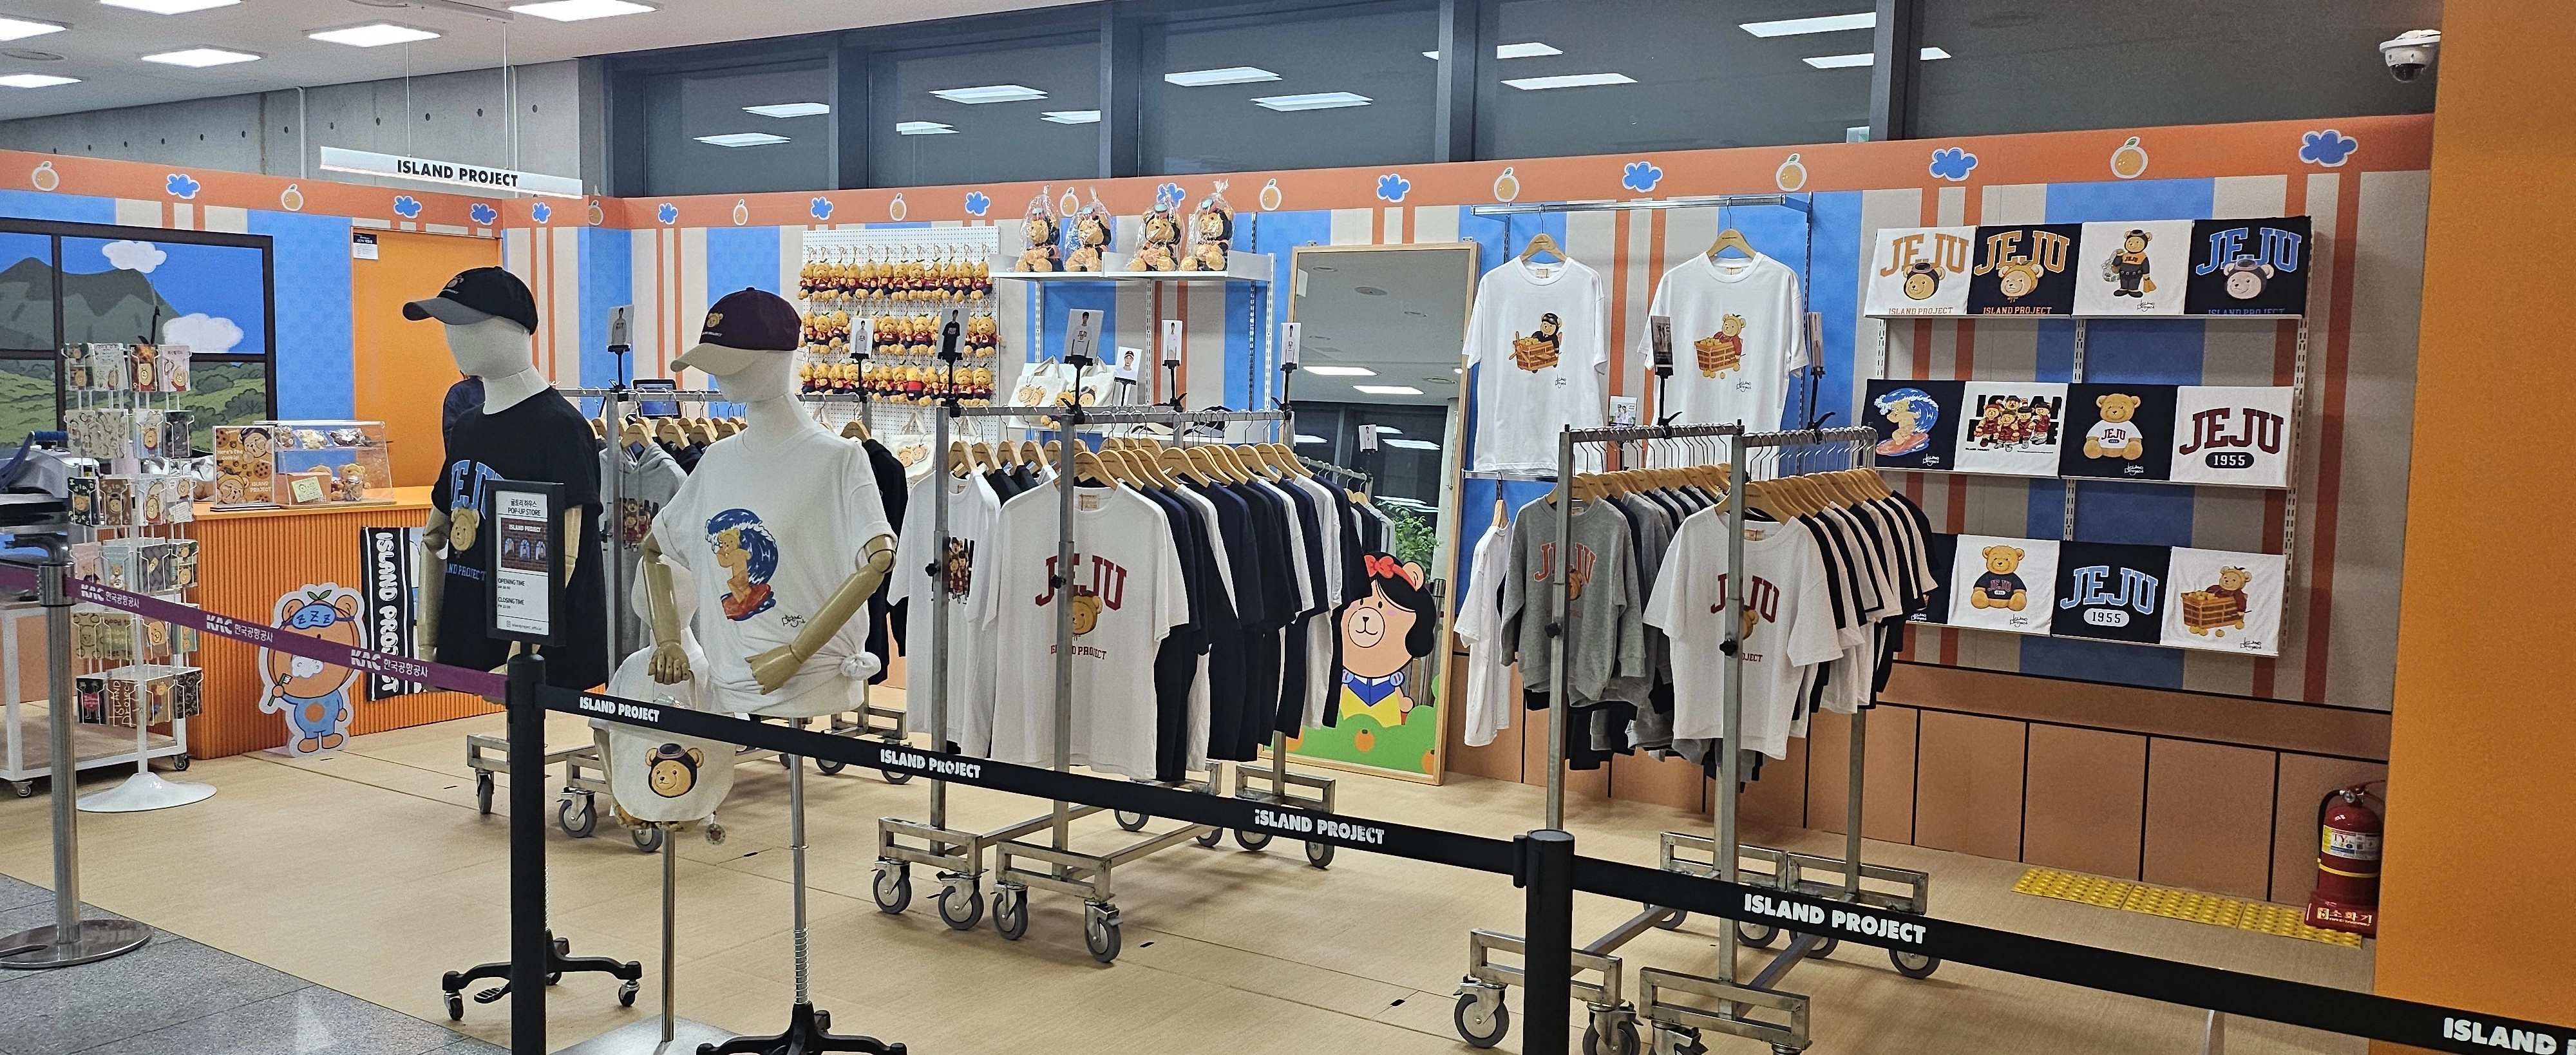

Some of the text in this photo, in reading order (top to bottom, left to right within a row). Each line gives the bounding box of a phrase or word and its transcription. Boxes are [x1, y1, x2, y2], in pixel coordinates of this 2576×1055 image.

[397, 159, 518, 187] ISLAND PROJECT
[1879, 233, 1969, 278] JEJU
[1973, 230, 2070, 277] JEJU
[2195, 227, 2302, 276] JEJU
[1888, 307, 1953, 315] ISLAND PROJECT
[2101, 428, 2126, 440] JEJU
[2179, 407, 2284, 455] JEJU
[2213, 455, 2245, 466] 1955
[375, 532, 397, 602] ISLAND
[1533, 541, 1596, 584] JJU
[80, 584, 140, 609] KAC 한국공항공사
[1710, 573, 1780, 623] JJU
[1987, 578, 2012, 592] JEJU
[2060, 565, 2159, 615] JEJU
[206, 614, 274, 643] KAC 한국공항공사
[2092, 611, 2121, 623] 1955
[351, 649, 428, 678] KAC 한국공항공사
[1077, 646, 1107, 660] PROJECT
[580, 696, 659, 723] ISLAND PROJECT
[880, 749, 981, 779] ISLAND PROJECT
[1317, 818, 1385, 845] PROJECT
[1743, 892, 1927, 946] ISLAND PROJECT
[2443, 1017, 2557, 1055] ISLAND
